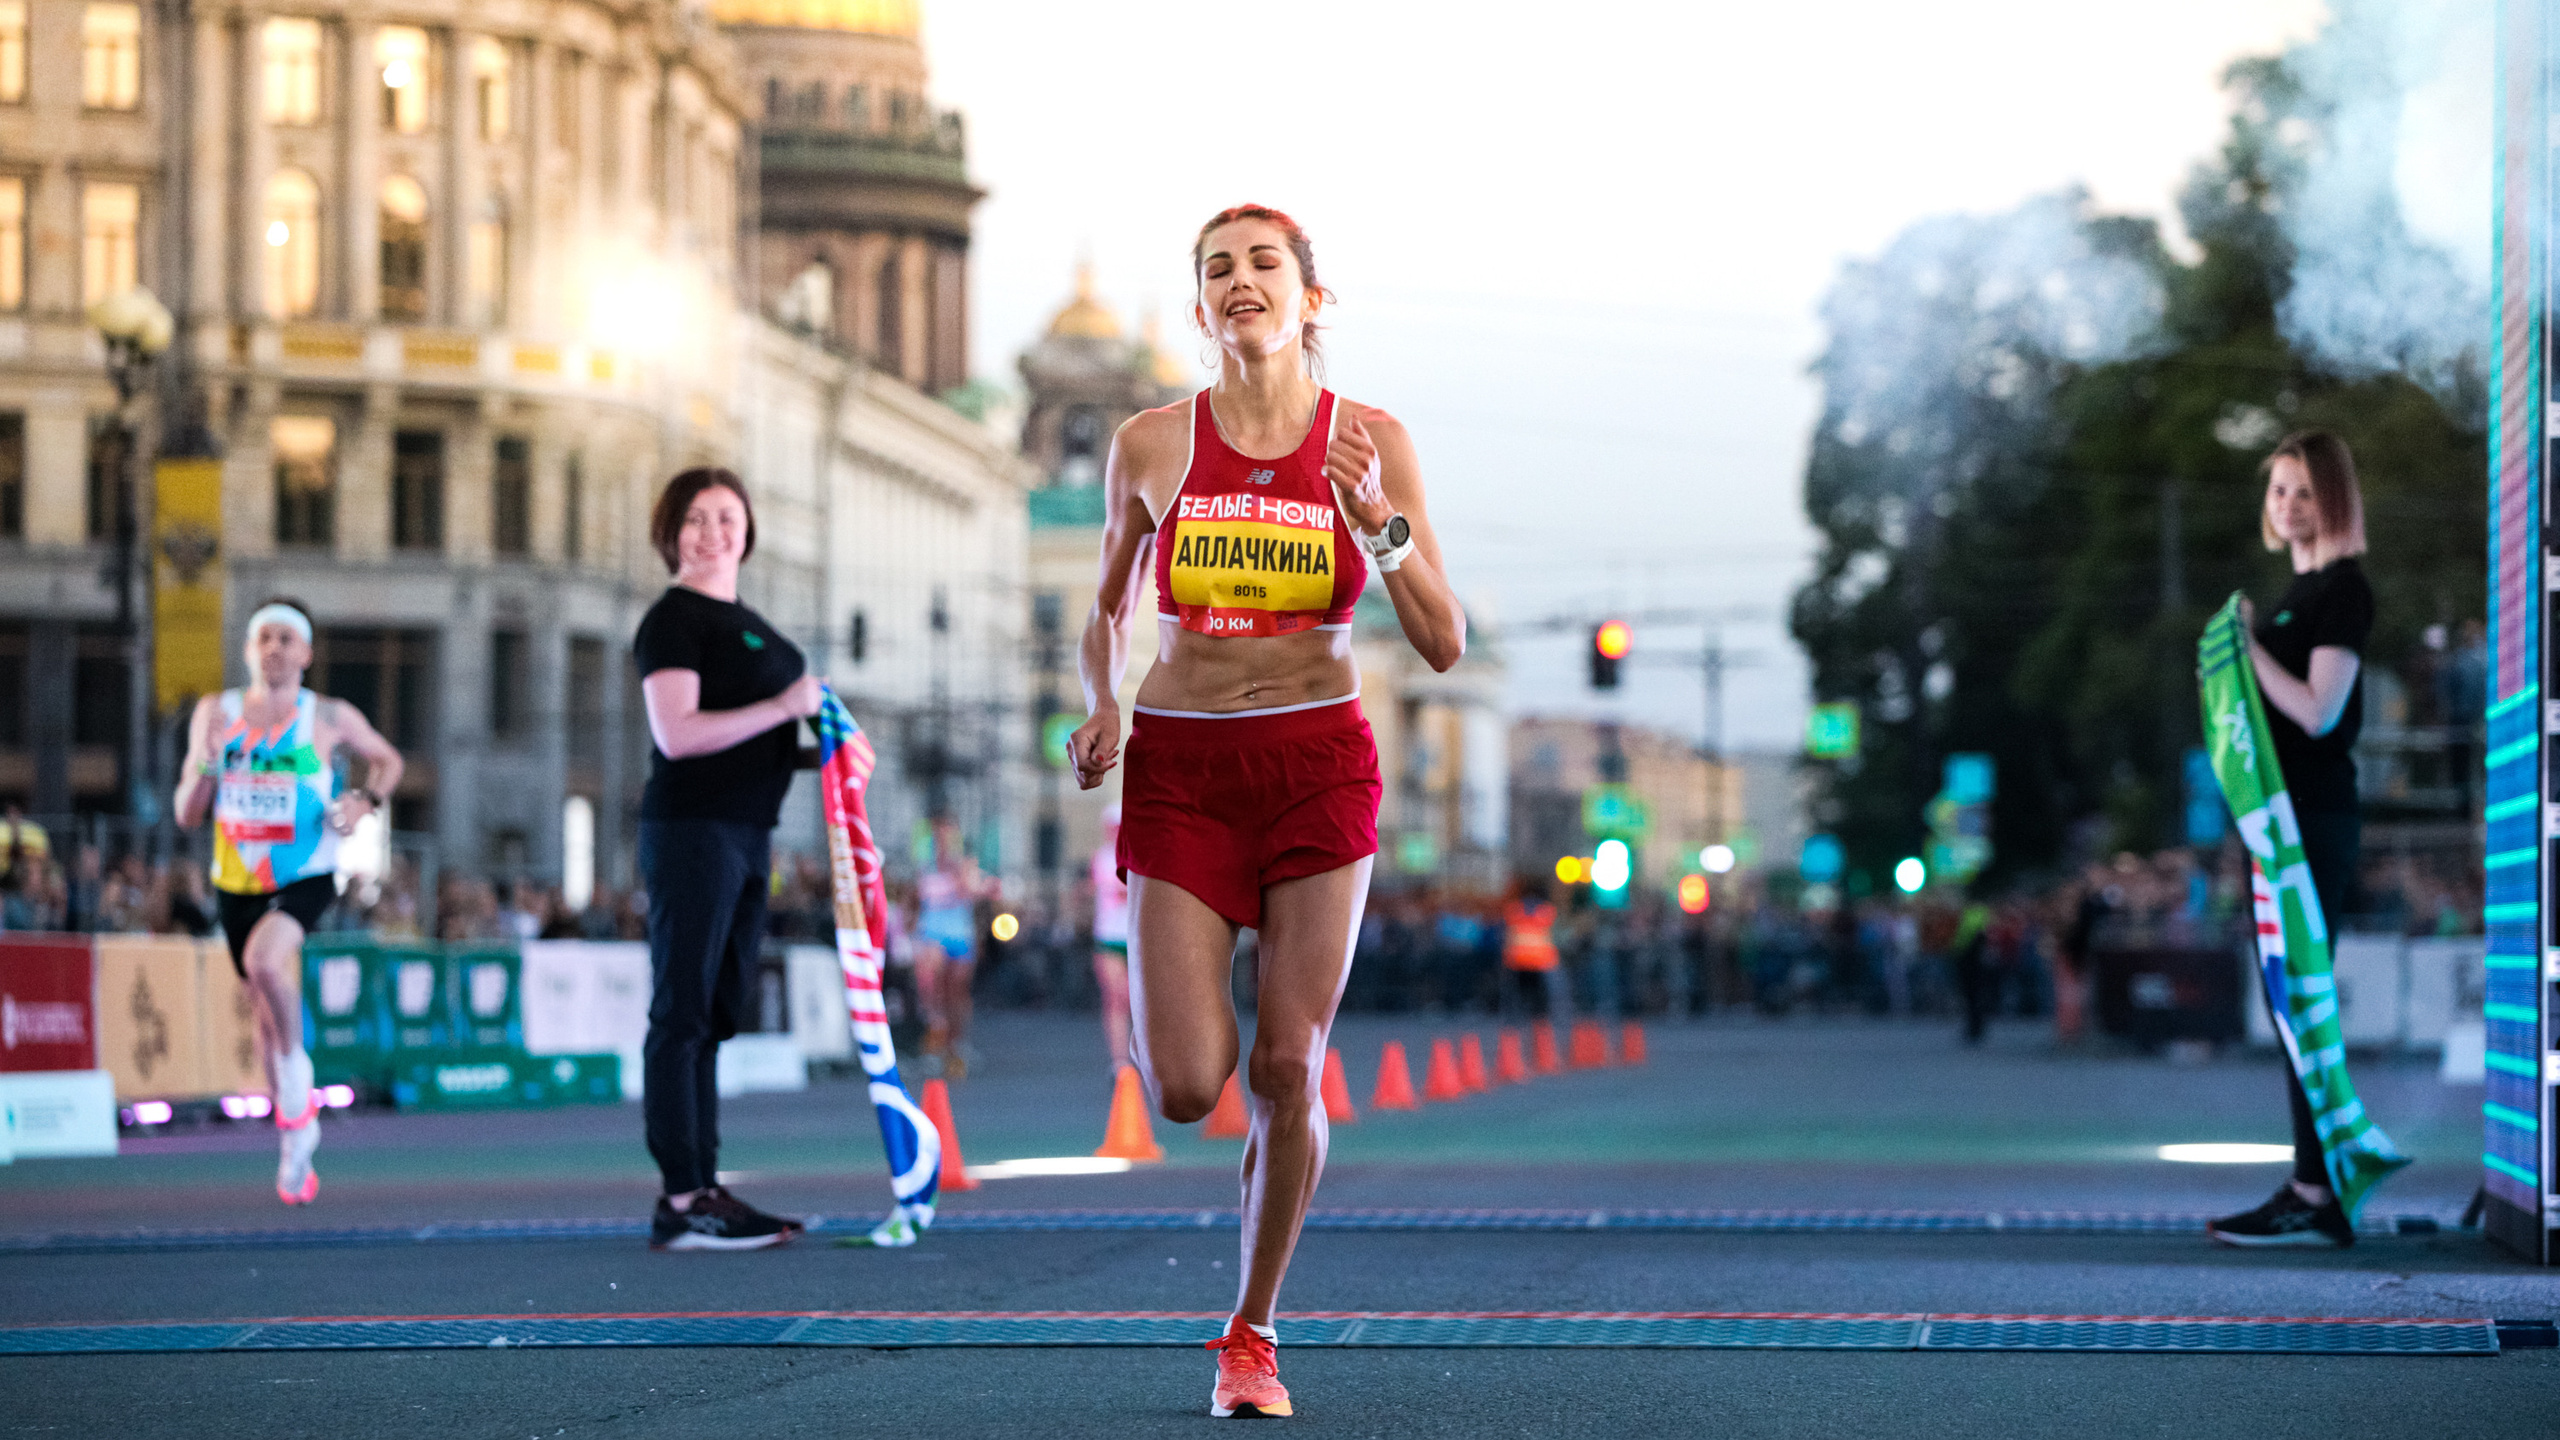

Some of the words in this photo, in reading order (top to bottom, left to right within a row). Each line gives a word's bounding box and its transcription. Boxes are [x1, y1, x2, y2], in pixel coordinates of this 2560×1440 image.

[1177, 494, 1253, 518] БЕЛЫЕ
[1259, 497, 1334, 530] НОЧИ
[1176, 535, 1329, 575] АПЛАЧКИНА
[1234, 585, 1267, 598] 8015
